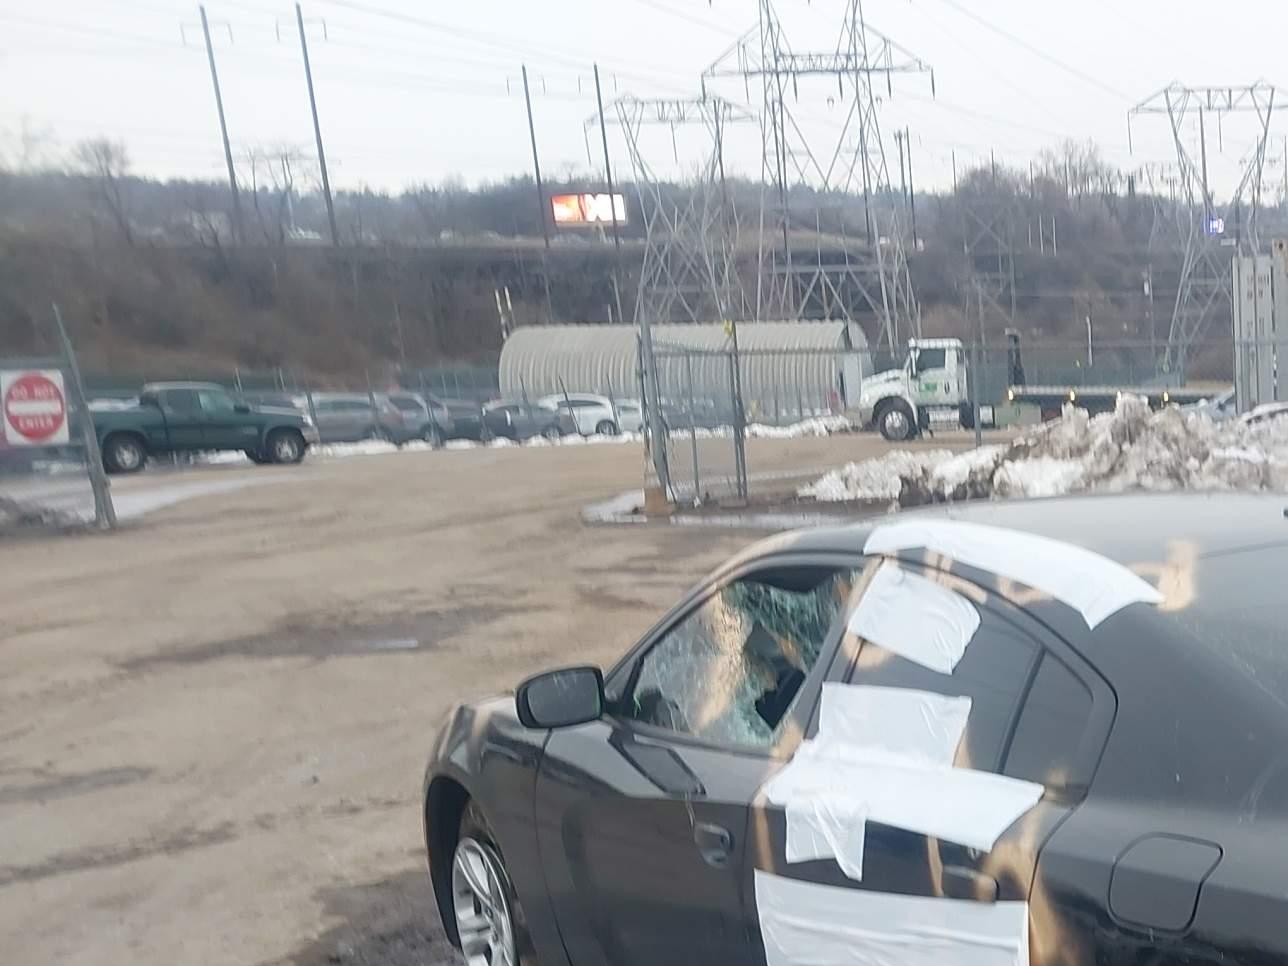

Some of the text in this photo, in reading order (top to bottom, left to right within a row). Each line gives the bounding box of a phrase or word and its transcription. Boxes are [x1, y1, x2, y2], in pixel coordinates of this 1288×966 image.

[12, 383, 57, 400] DO NOT
[19, 414, 53, 430] ENTER
